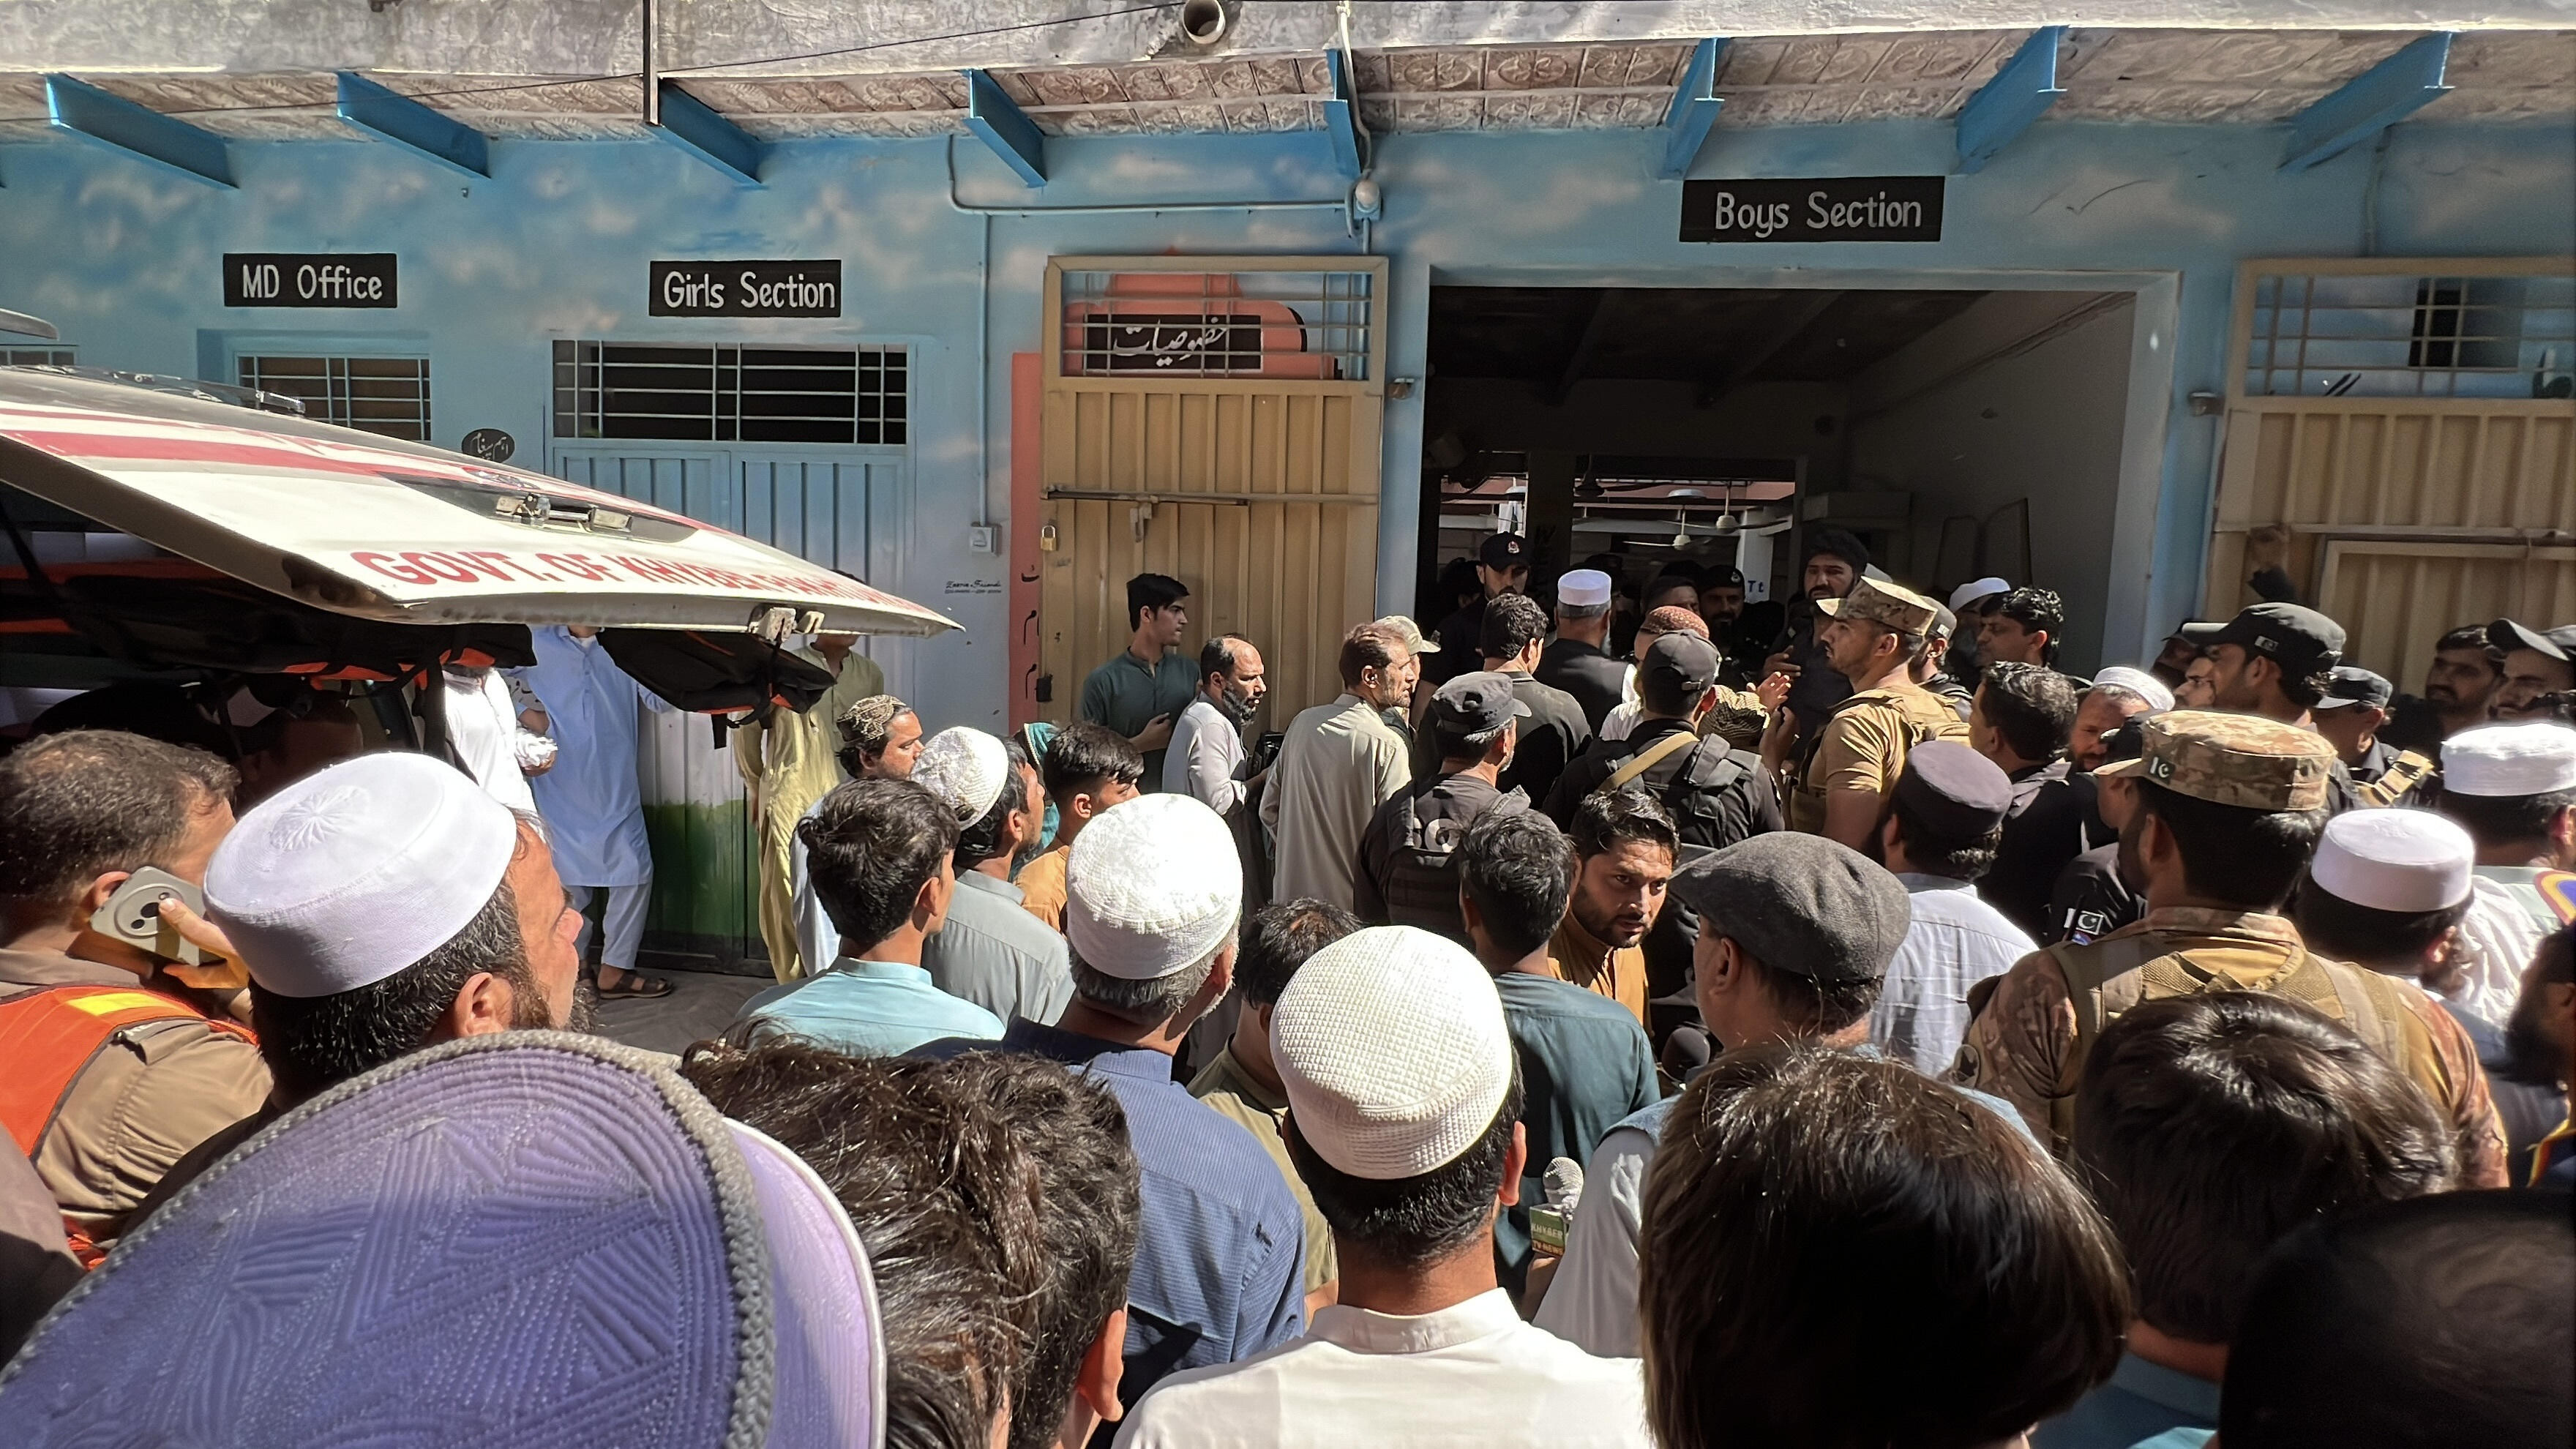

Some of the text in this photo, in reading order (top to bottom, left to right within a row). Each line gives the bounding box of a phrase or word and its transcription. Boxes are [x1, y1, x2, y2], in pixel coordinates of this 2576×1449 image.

[1715, 191, 1922, 238] Boys Section
[242, 263, 383, 300] MD Office
[663, 271, 836, 309] Girls Section
[350, 551, 566, 585] GOVT.
[535, 553, 626, 582] OF
[600, 555, 785, 594] KHYBER
[1531, 1223, 1563, 1239] KHYBER
